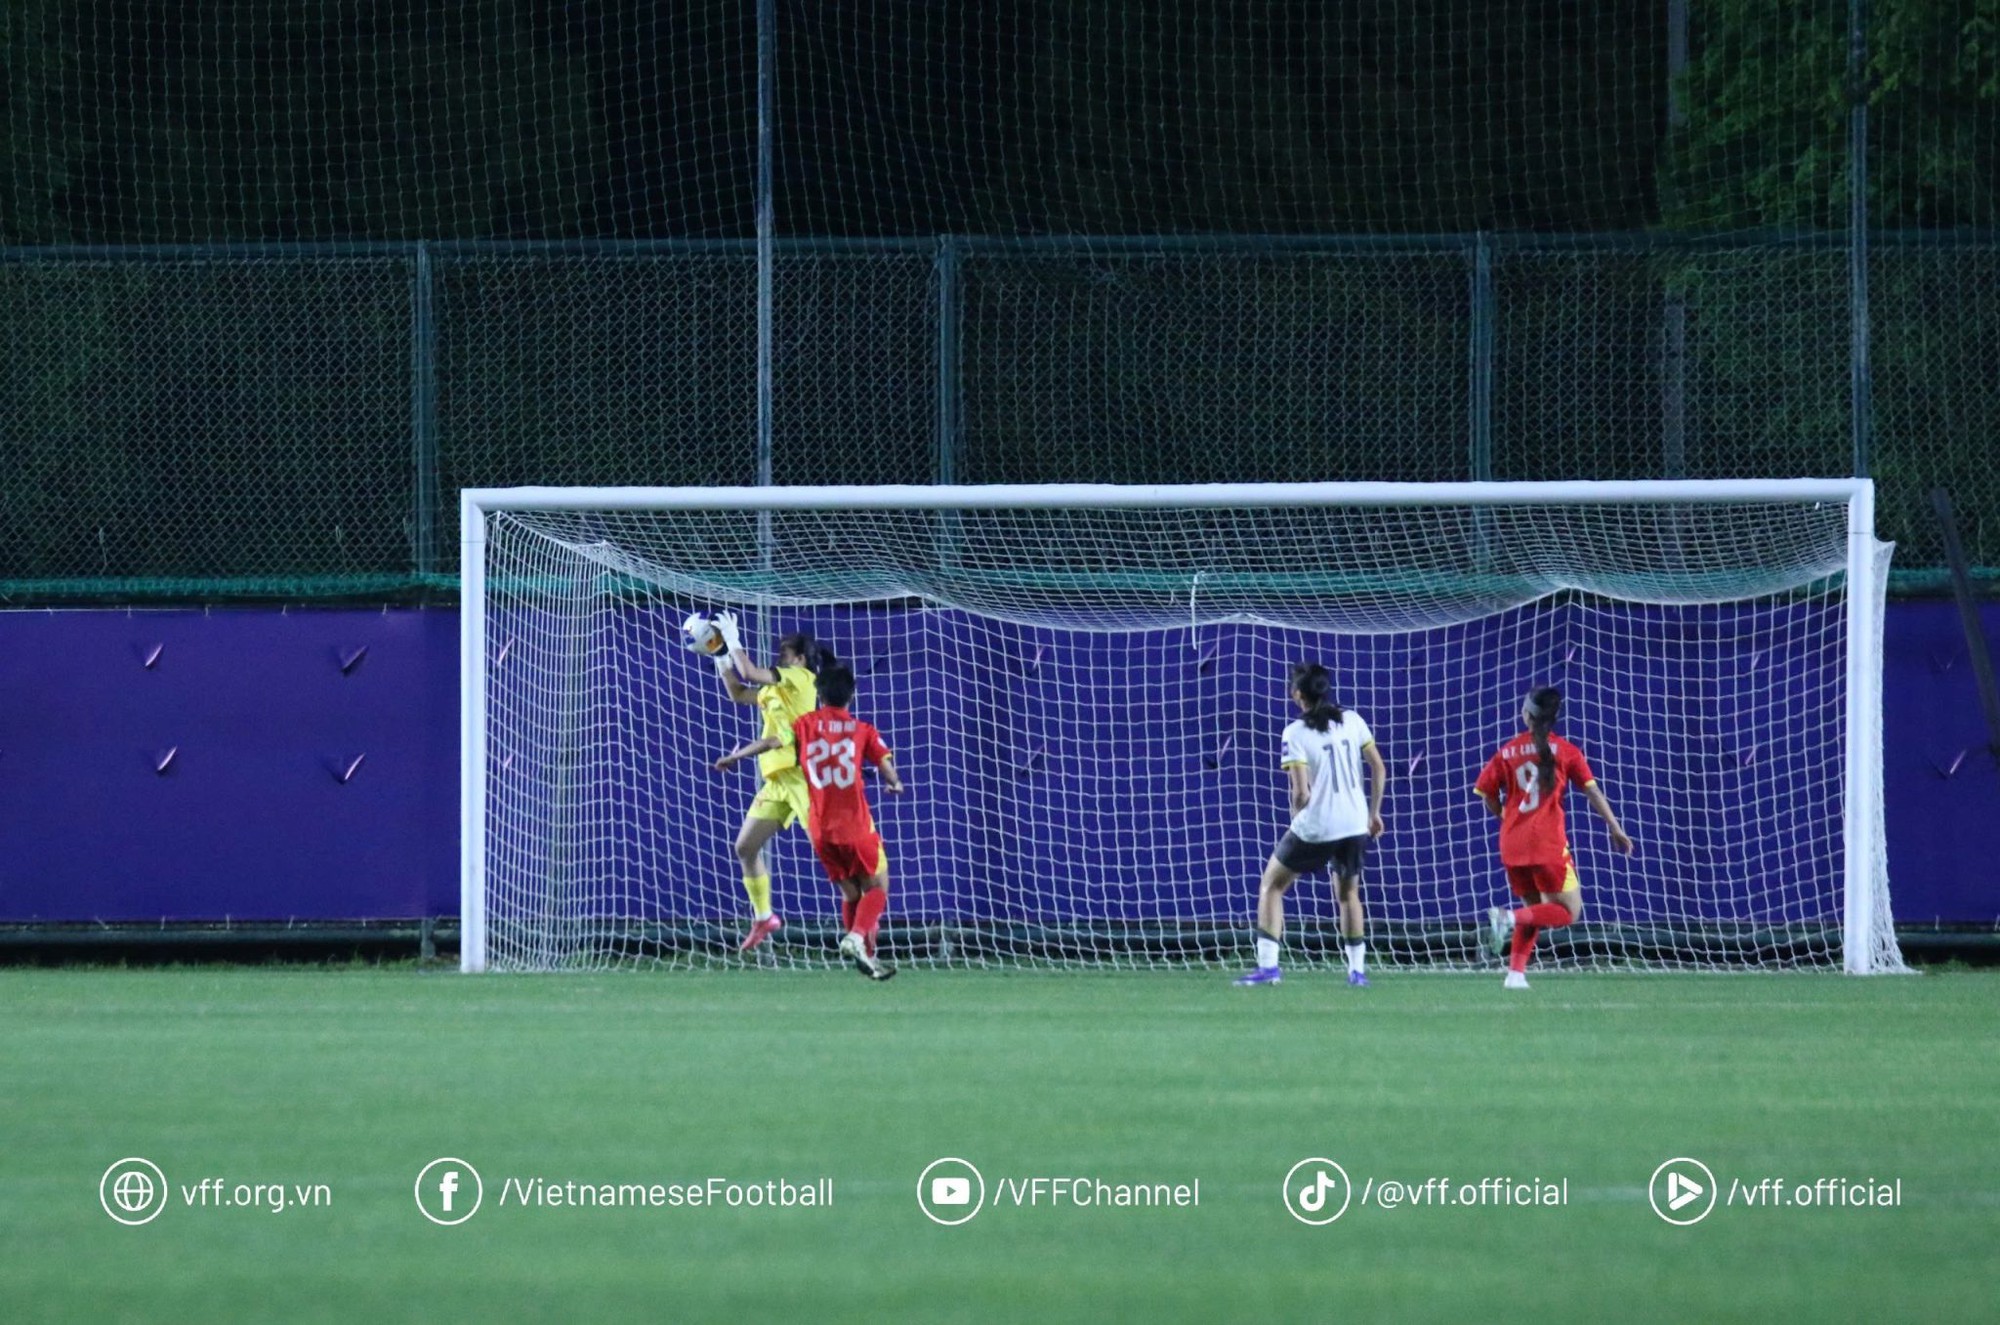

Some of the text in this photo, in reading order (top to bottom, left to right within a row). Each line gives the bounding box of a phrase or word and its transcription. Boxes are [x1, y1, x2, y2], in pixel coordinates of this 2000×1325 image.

[806, 737, 857, 790] 23
[1322, 739, 1356, 794] 11
[1515, 760, 1541, 814] 9
